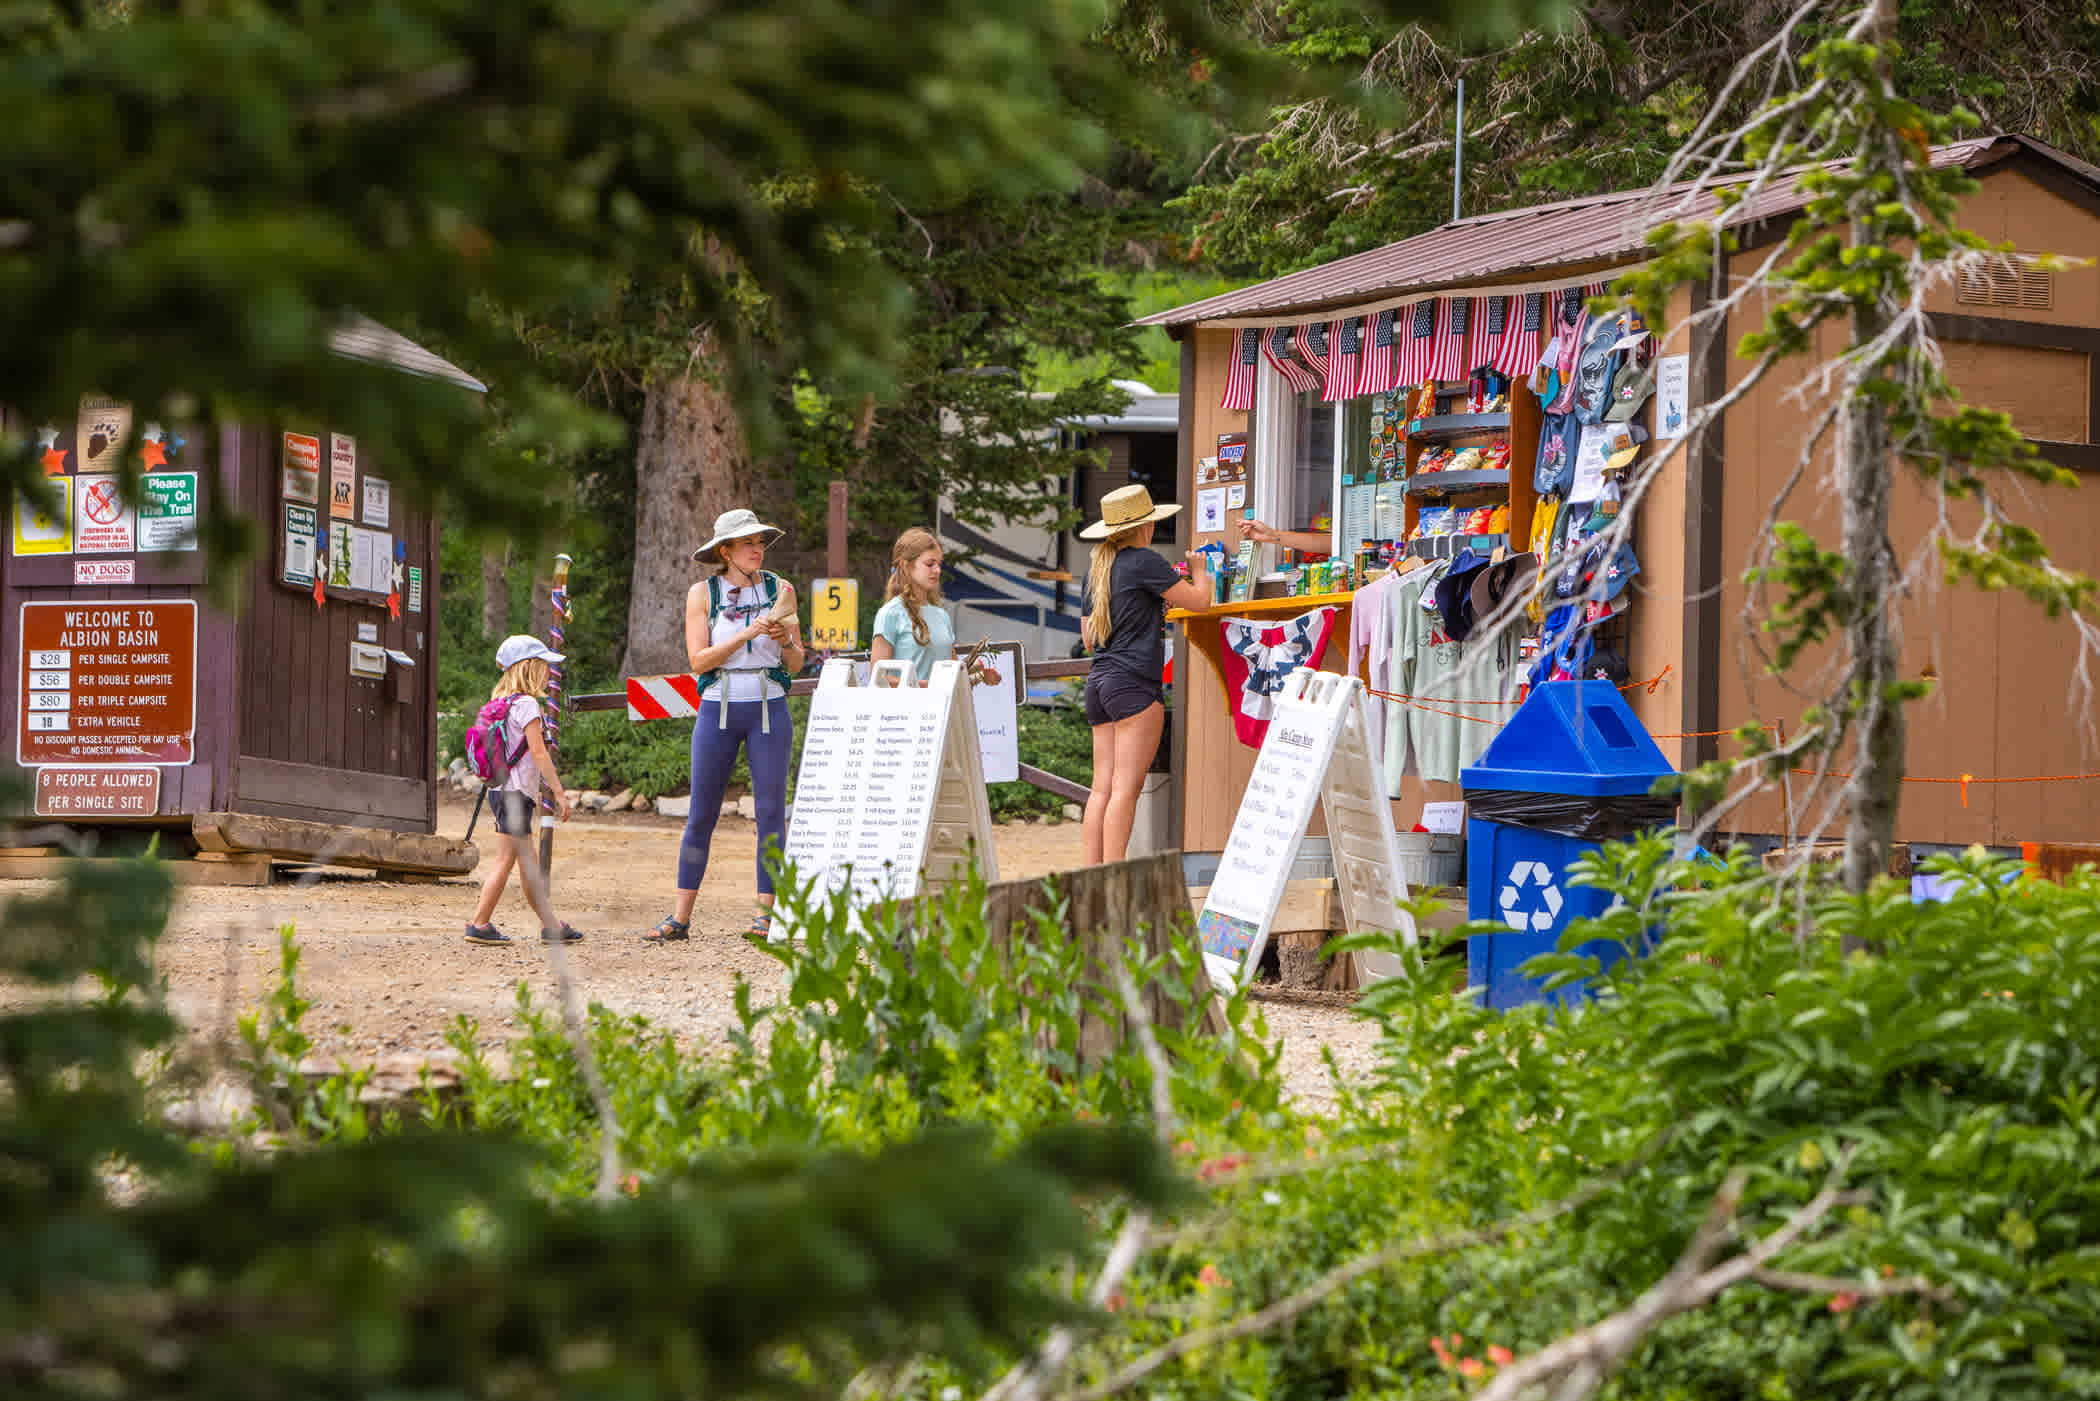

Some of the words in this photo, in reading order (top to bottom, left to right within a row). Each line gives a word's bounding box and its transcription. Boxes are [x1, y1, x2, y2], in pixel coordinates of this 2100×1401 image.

[148, 478, 187, 490] Please
[175, 490, 191, 501] On
[169, 502, 193, 515] Trail
[80, 565, 96, 575] NO
[99, 565, 130, 575] DOGS
[828, 586, 841, 611] 5
[65, 611, 130, 628] WELCOME
[138, 611, 154, 627] TO
[60, 631, 110, 648] ALBION
[118, 630, 158, 647] BASIN
[40, 653, 61, 666] $28
[78, 653, 95, 665] PER
[98, 653, 128, 665] SINGLE
[131, 653, 170, 665] CAMPSITE
[39, 673, 60, 686] $56
[78, 674, 95, 686] PER
[98, 674, 130, 686] DOUBLE
[134, 674, 173, 686] CAMPSITE
[39, 694, 61, 707] $80
[77, 695, 94, 706] PER
[97, 695, 125, 706] TRIPLE
[128, 695, 168, 706] CAMPSITE
[77, 716, 103, 728] EXTRA
[106, 716, 141, 727] VEHICLE
[34, 735, 44, 745] NO
[45, 735, 76, 745] DISCOUNT
[78, 735, 102, 745] PASSES
[104, 735, 137, 744] ACCEPTED
[138, 735, 151, 744] FOR
[153, 735, 165, 744] DAY
[166, 735, 180, 745] USE
[71, 746, 82, 755] NO
[82, 746, 114, 755] DOMESTIC
[43, 774, 51, 787] 8
[56, 774, 97, 788] PEOPLE
[102, 774, 153, 787] ALLOWED
[48, 796, 70, 809] PER
[75, 796, 114, 809] SINGLE
[120, 796, 144, 809] SITE
